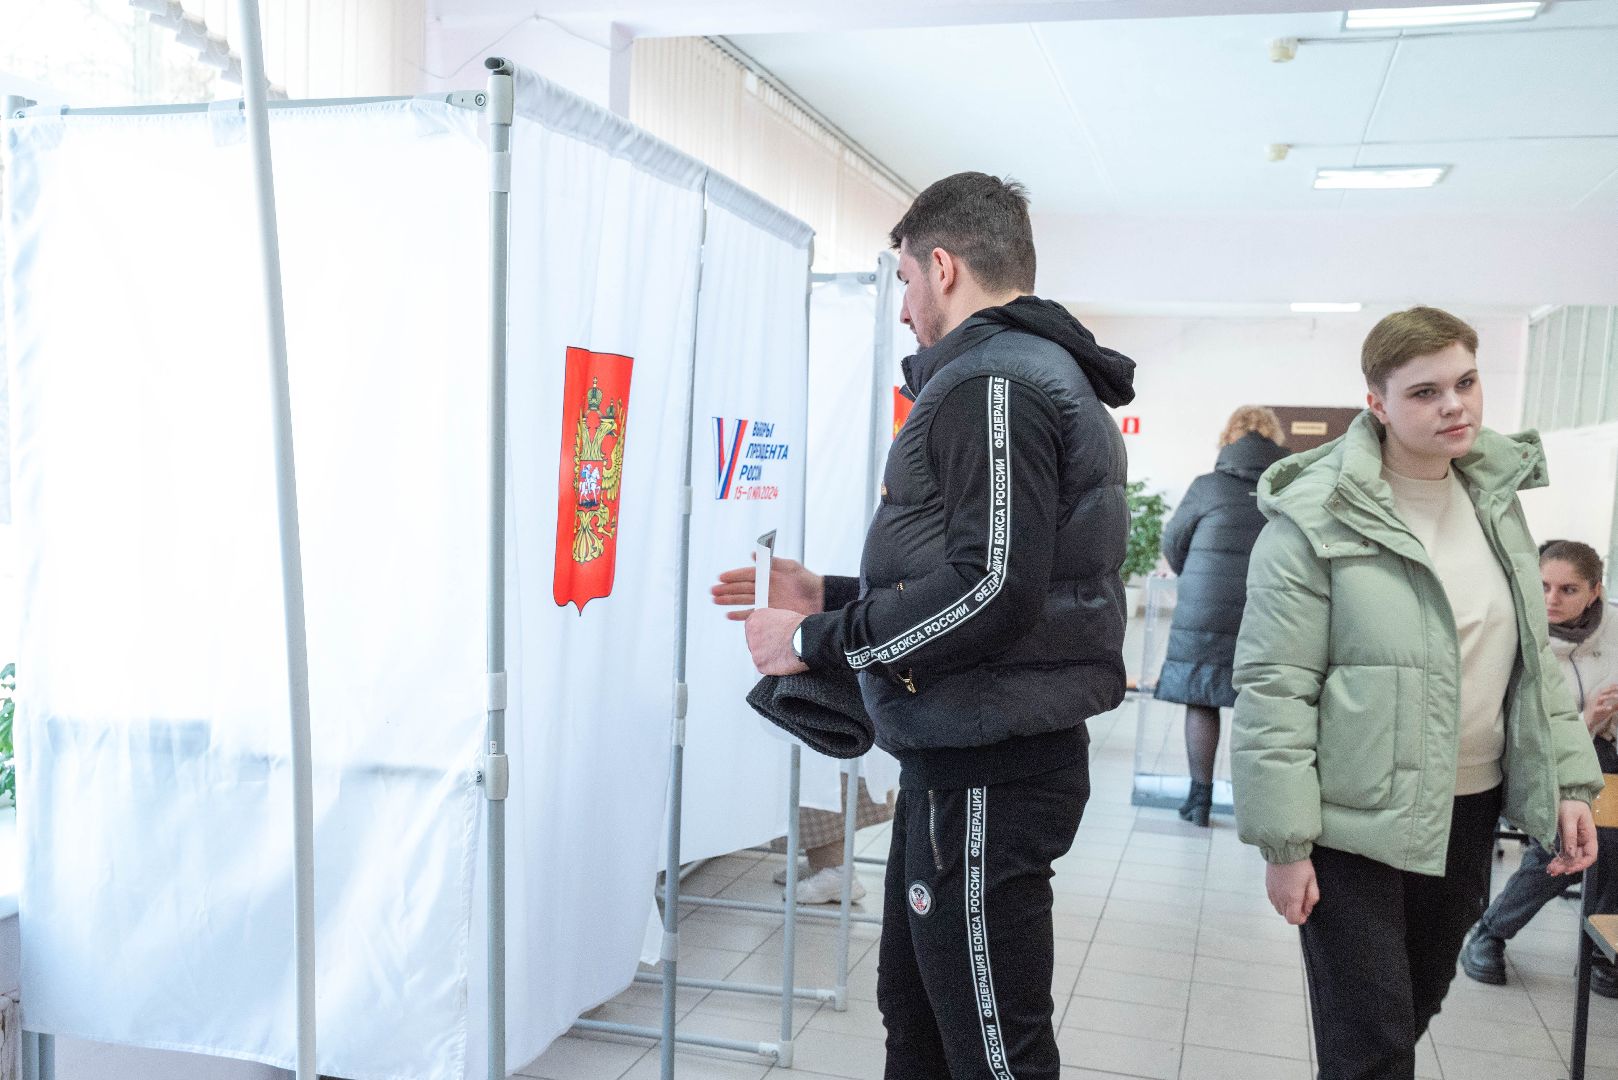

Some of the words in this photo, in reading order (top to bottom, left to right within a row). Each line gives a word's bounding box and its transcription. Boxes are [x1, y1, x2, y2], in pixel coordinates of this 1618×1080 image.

[993, 383, 1006, 449] ФЕДЕРАЦИЯ
[995, 458, 1005, 506] РОССИИ
[994, 508, 1005, 546] БОКСА
[924, 603, 970, 636] РОССИИ
[891, 631, 925, 656] БОКСА
[970, 787, 983, 858] ФЕДЕРАЦИЯ
[970, 866, 981, 913] РОССИИ
[972, 915, 983, 952] БОКСА
[975, 953, 993, 1018] ФЕДЕРАЦИЯ
[986, 1024, 1003, 1069] РОССИИ
